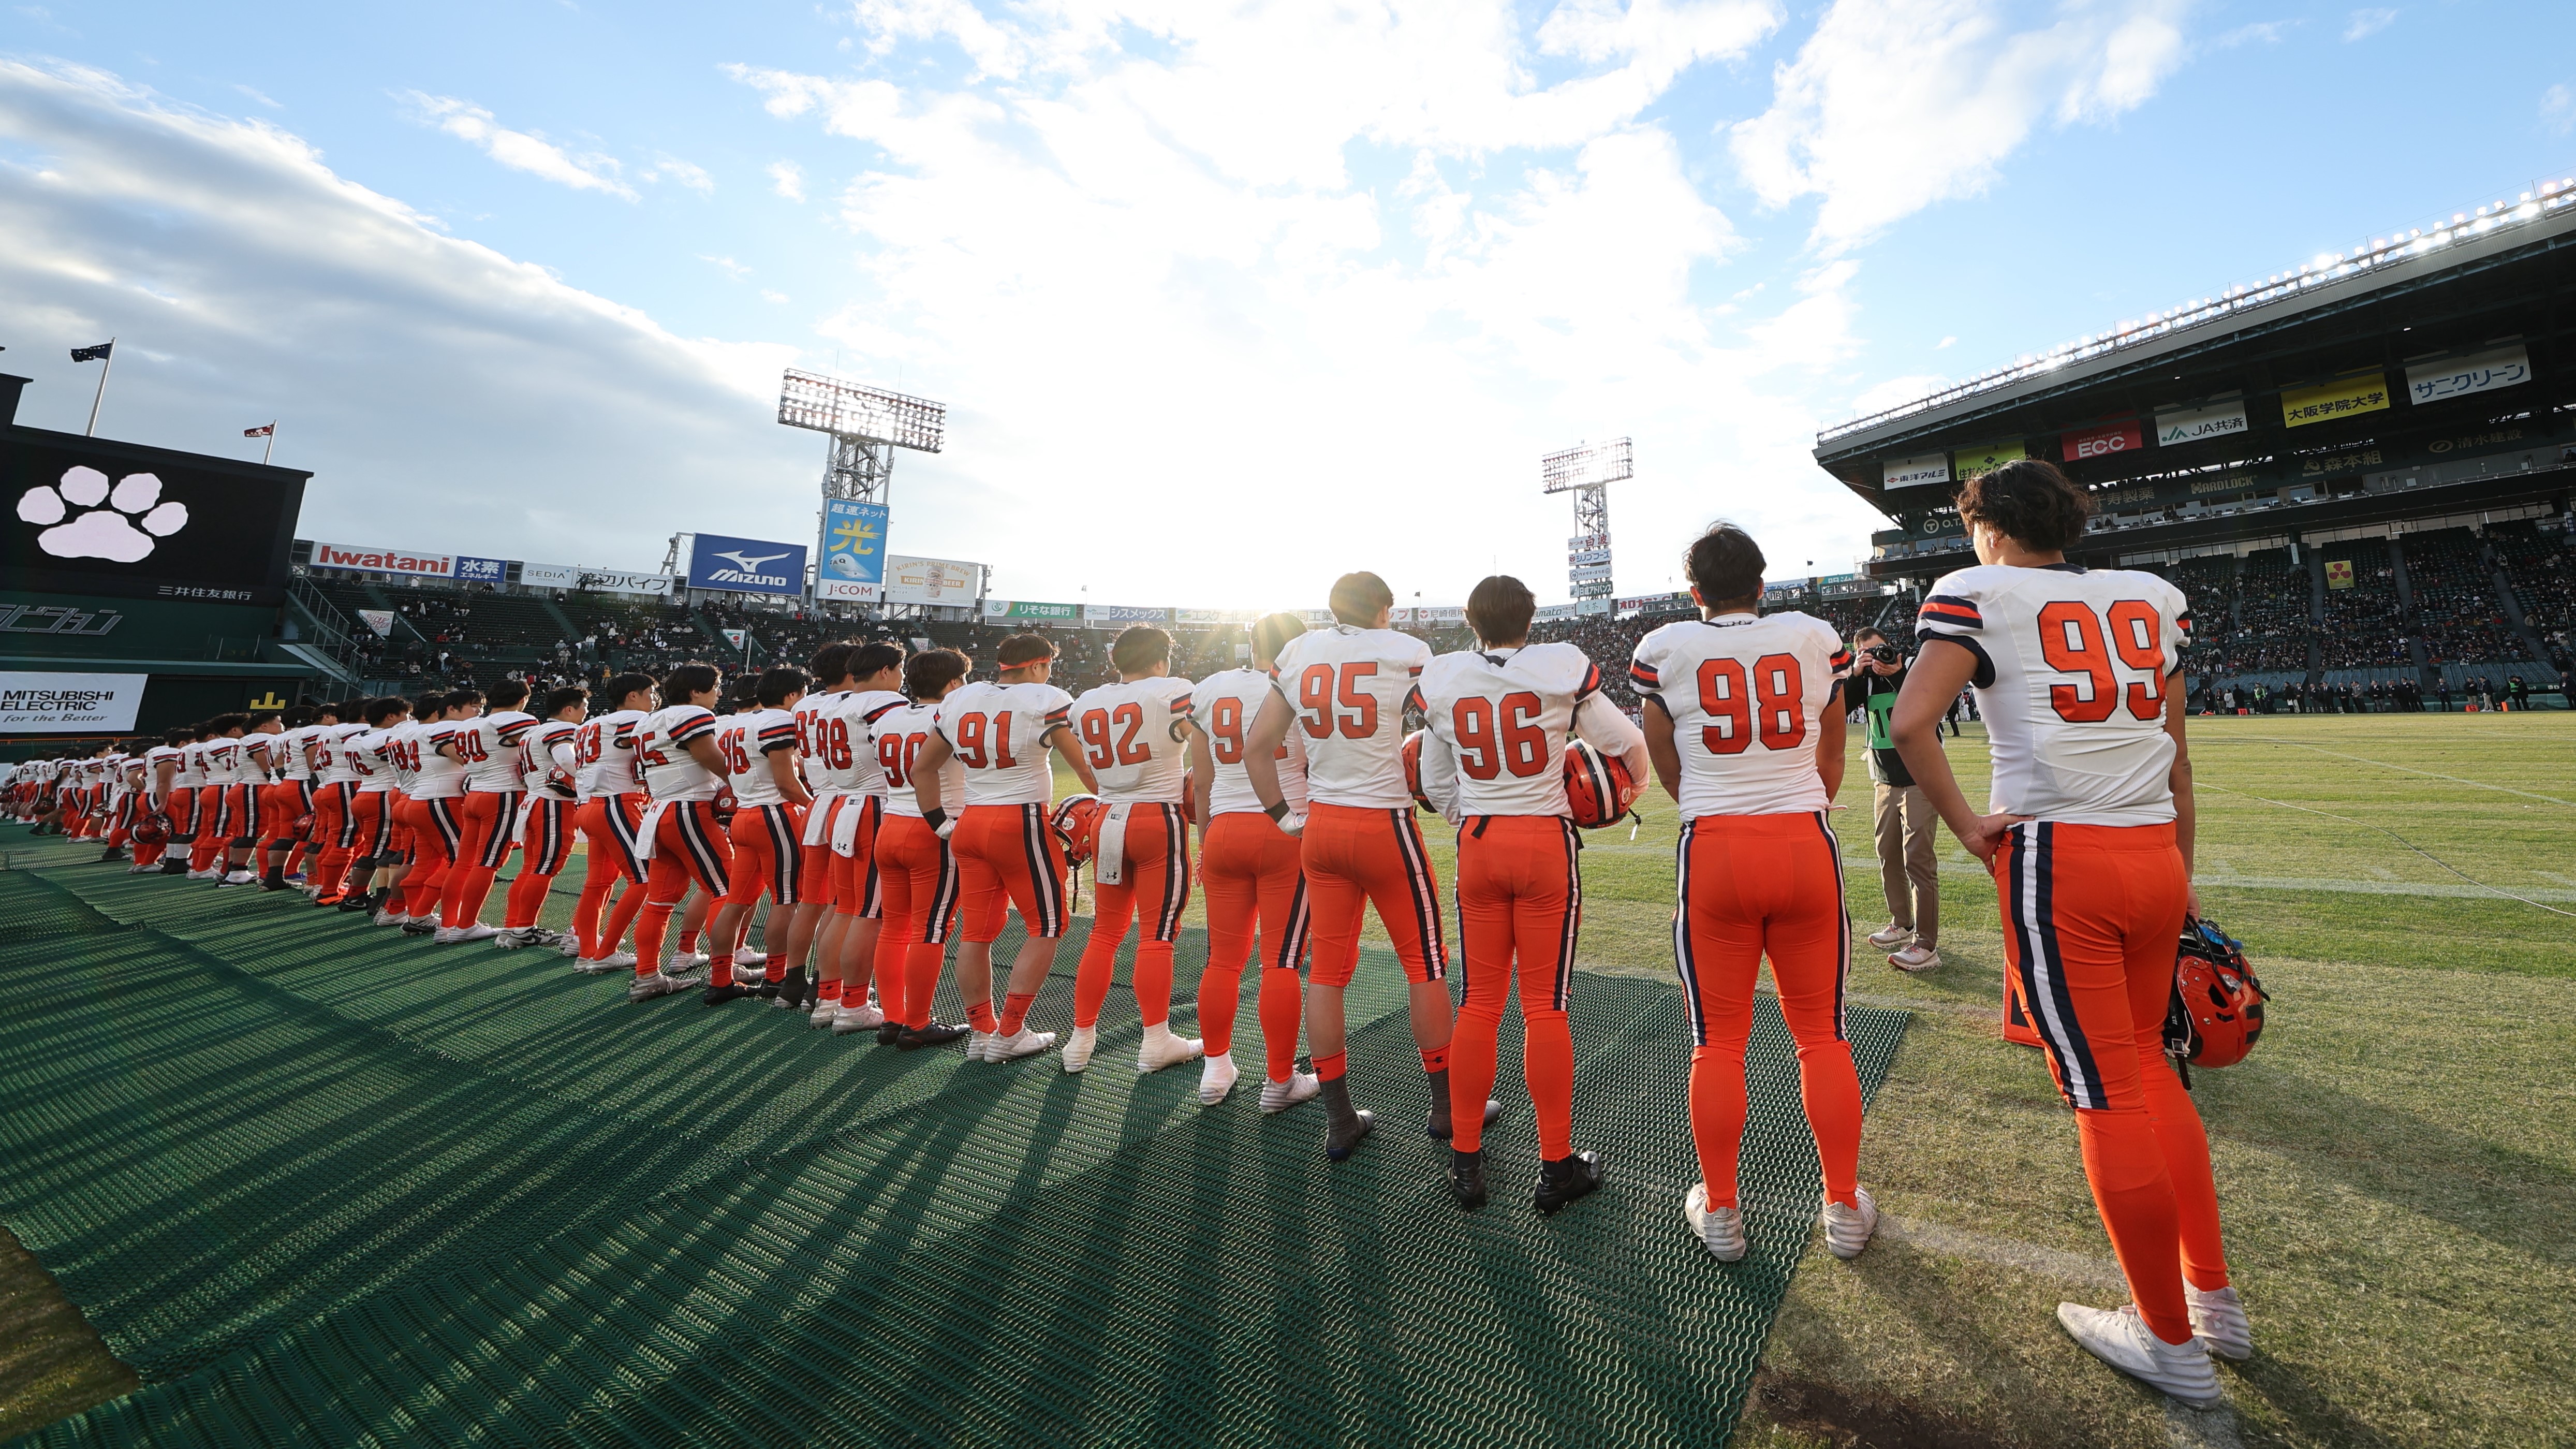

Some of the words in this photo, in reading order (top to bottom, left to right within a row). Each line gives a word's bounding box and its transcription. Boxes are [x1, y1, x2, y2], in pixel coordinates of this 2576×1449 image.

[2415, 364, 2524, 399] サニクリーン
[2288, 391, 2384, 421] 大阪学院大学
[2191, 417, 2244, 436] JA共済
[2078, 436, 2125, 458] ECC
[2457, 429, 2523, 449] 清水建設
[1959, 461, 2008, 479] 住友ベーク
[2324, 450, 2383, 472] 森本組
[1900, 469, 1946, 482] 東洋アルミ
[2095, 486, 2155, 507] 千寿製薬
[830, 503, 887, 519] 超速ネット
[829, 519, 882, 555] 光
[1585, 533, 1608, 547] 白波
[319, 545, 450, 574] Iwatani
[1576, 550, 1610, 562] シノブフーズ
[461, 560, 501, 575] 水素
[527, 569, 565, 579] SEDIA
[896, 561, 924, 572] KIRIN'S
[951, 565, 971, 577] BREW
[157, 586, 253, 601] 三井住友銀行
[827, 584, 873, 596] J:COM
[1019, 605, 1071, 616] りそな銀行
[1585, 602, 1598, 611] 生茶
[1619, 595, 1671, 610] オロナ
[1111, 608, 1166, 620] シスメックス
[2037, 600, 2167, 723] 99
[3, 690, 114, 700] MITSUBISHI
[1300, 661, 1378, 739] 95
[1697, 652, 1806, 754] 98
[0, 701, 97, 711] ELECTRIC
[3, 714, 29, 723] for
[61, 713, 108, 722] Better
[796, 709, 818, 758] 8
[957, 711, 1017, 770] 91
[1081, 702, 1152, 770] 92
[1452, 691, 1549, 780] 96
[454, 729, 489, 764] 80
[344, 751, 374, 775] 76
[878, 732, 930, 788] 90
